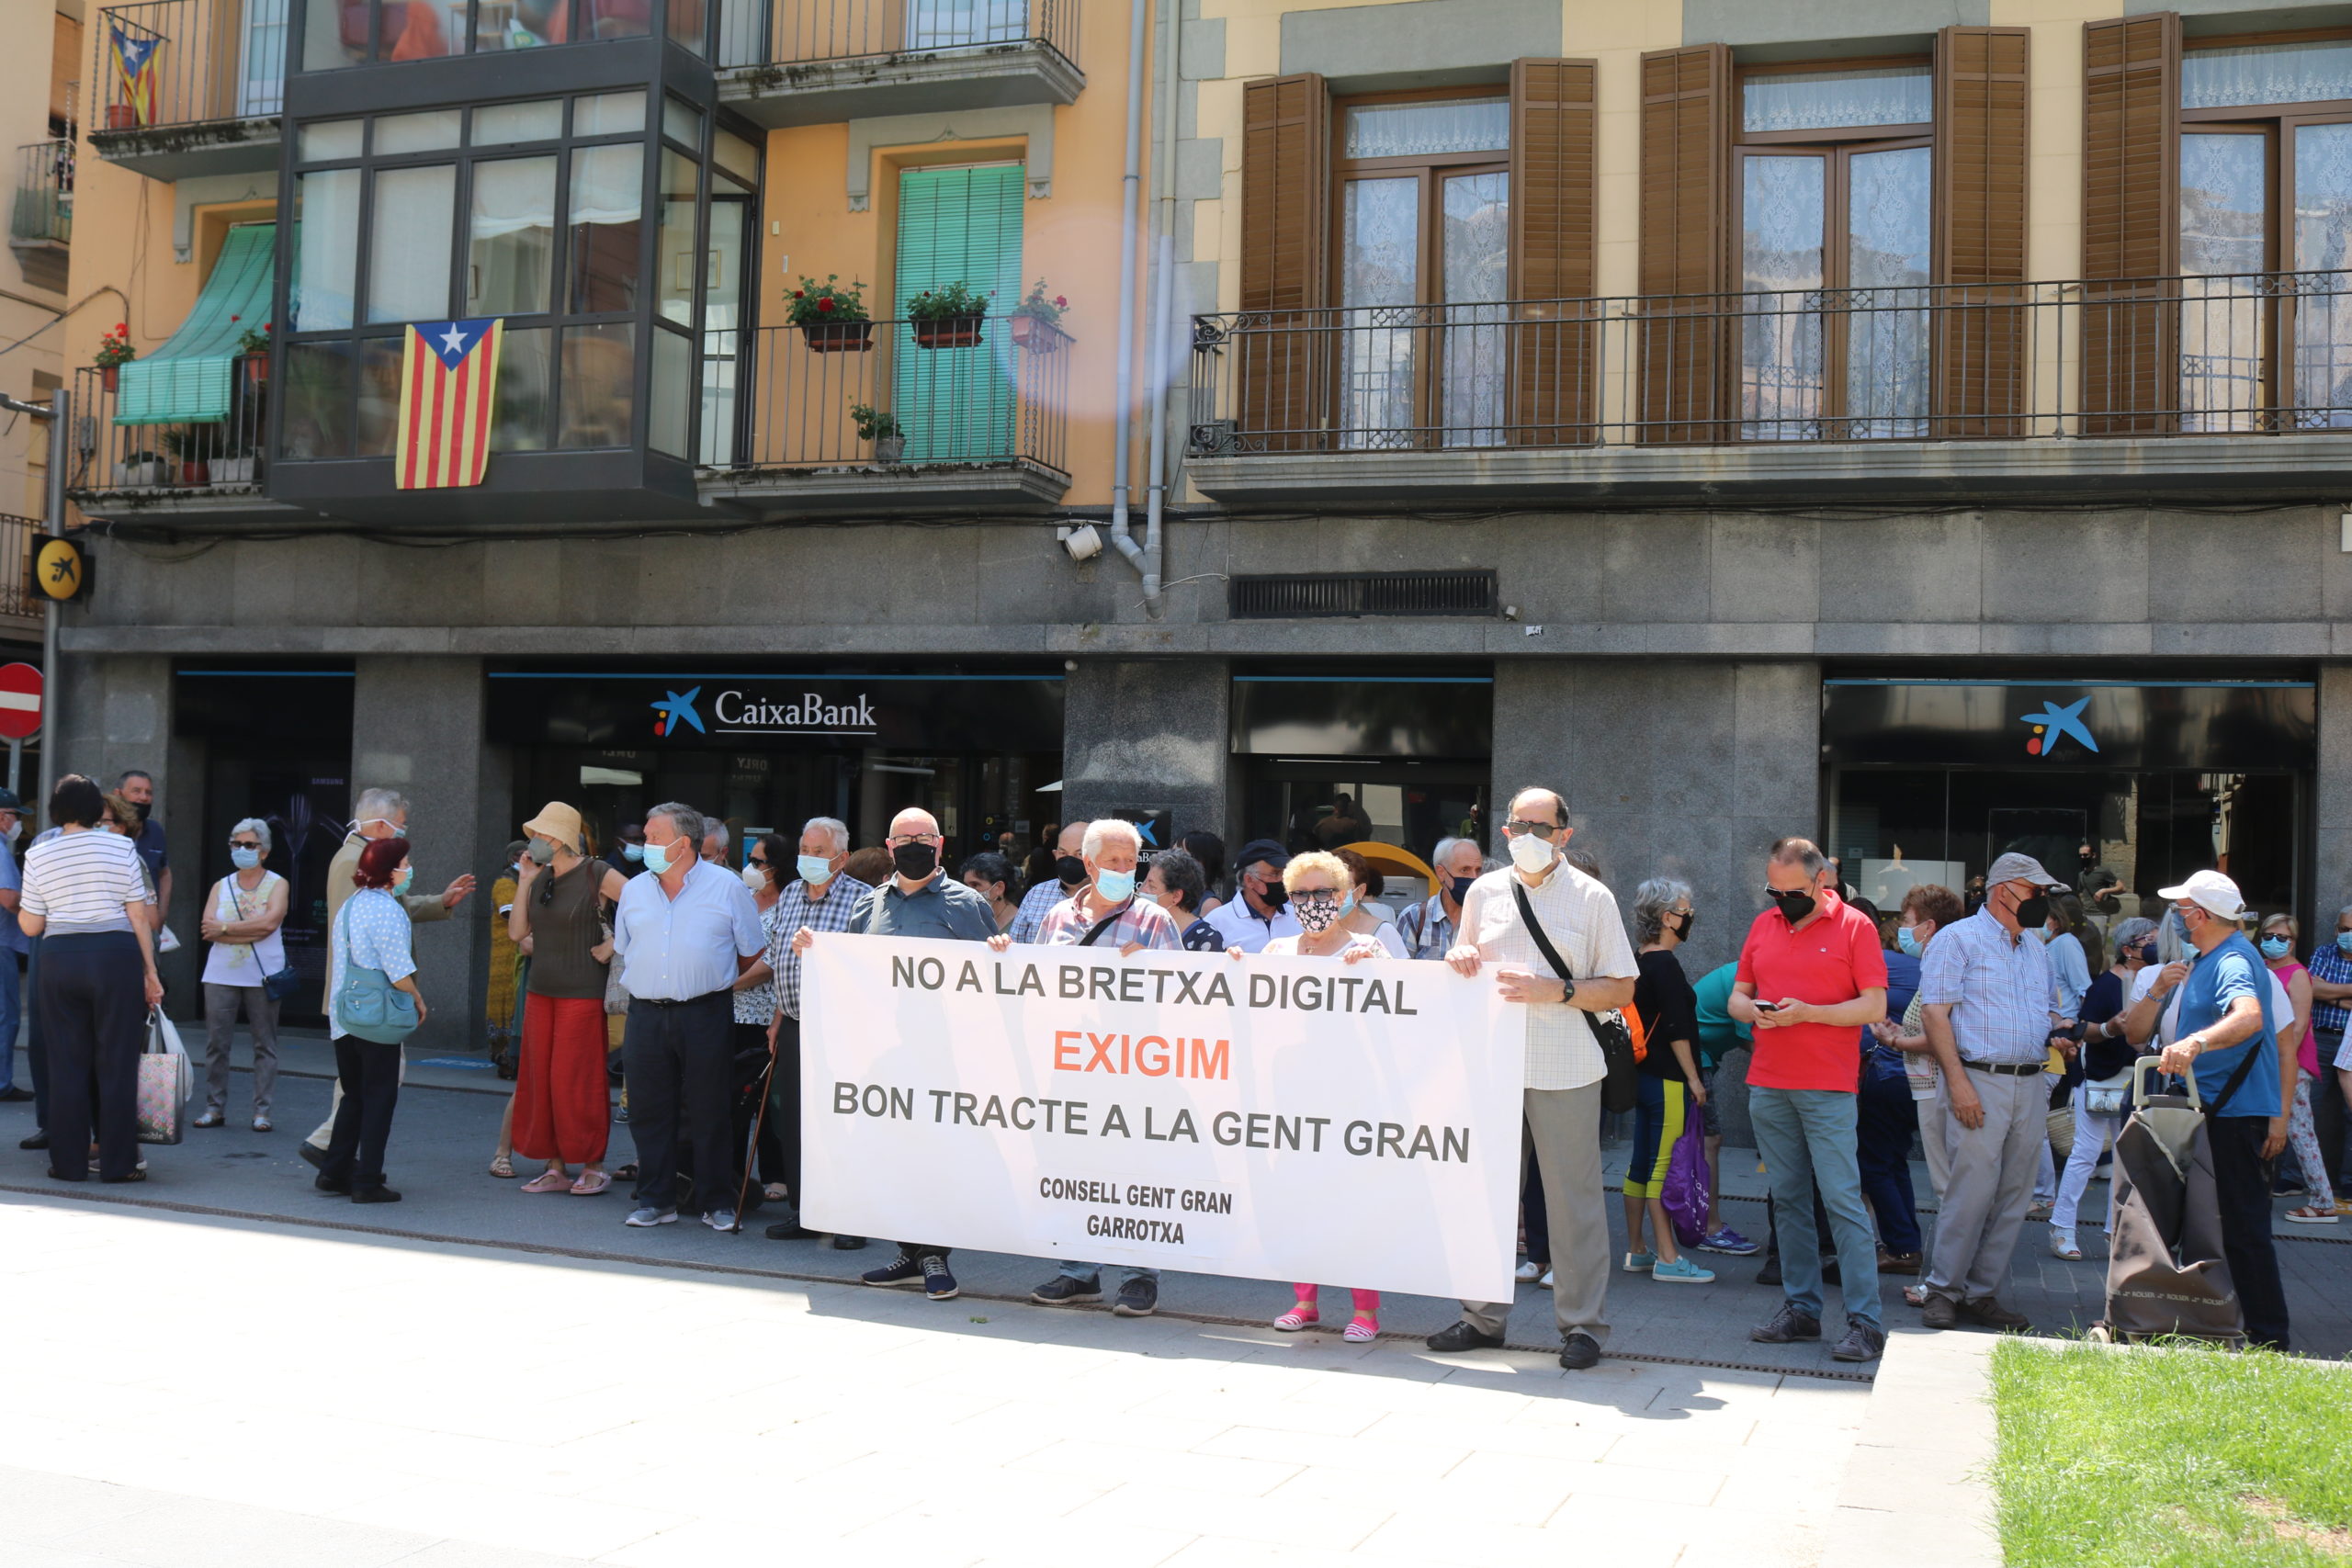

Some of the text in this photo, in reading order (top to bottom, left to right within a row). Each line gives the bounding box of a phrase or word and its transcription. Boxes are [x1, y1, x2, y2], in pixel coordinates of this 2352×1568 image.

[715, 690, 877, 726] CaixaBank
[893, 956, 1418, 1016] NO A LA BRETXA DIGITAL
[1054, 1031, 1230, 1080] EXIGIM
[833, 1082, 1470, 1164] BON TRACTE A LA GENT GRAN
[1039, 1177, 1232, 1215] CONSELL GENT GRAN
[1087, 1214, 1184, 1245] GARROTXA
